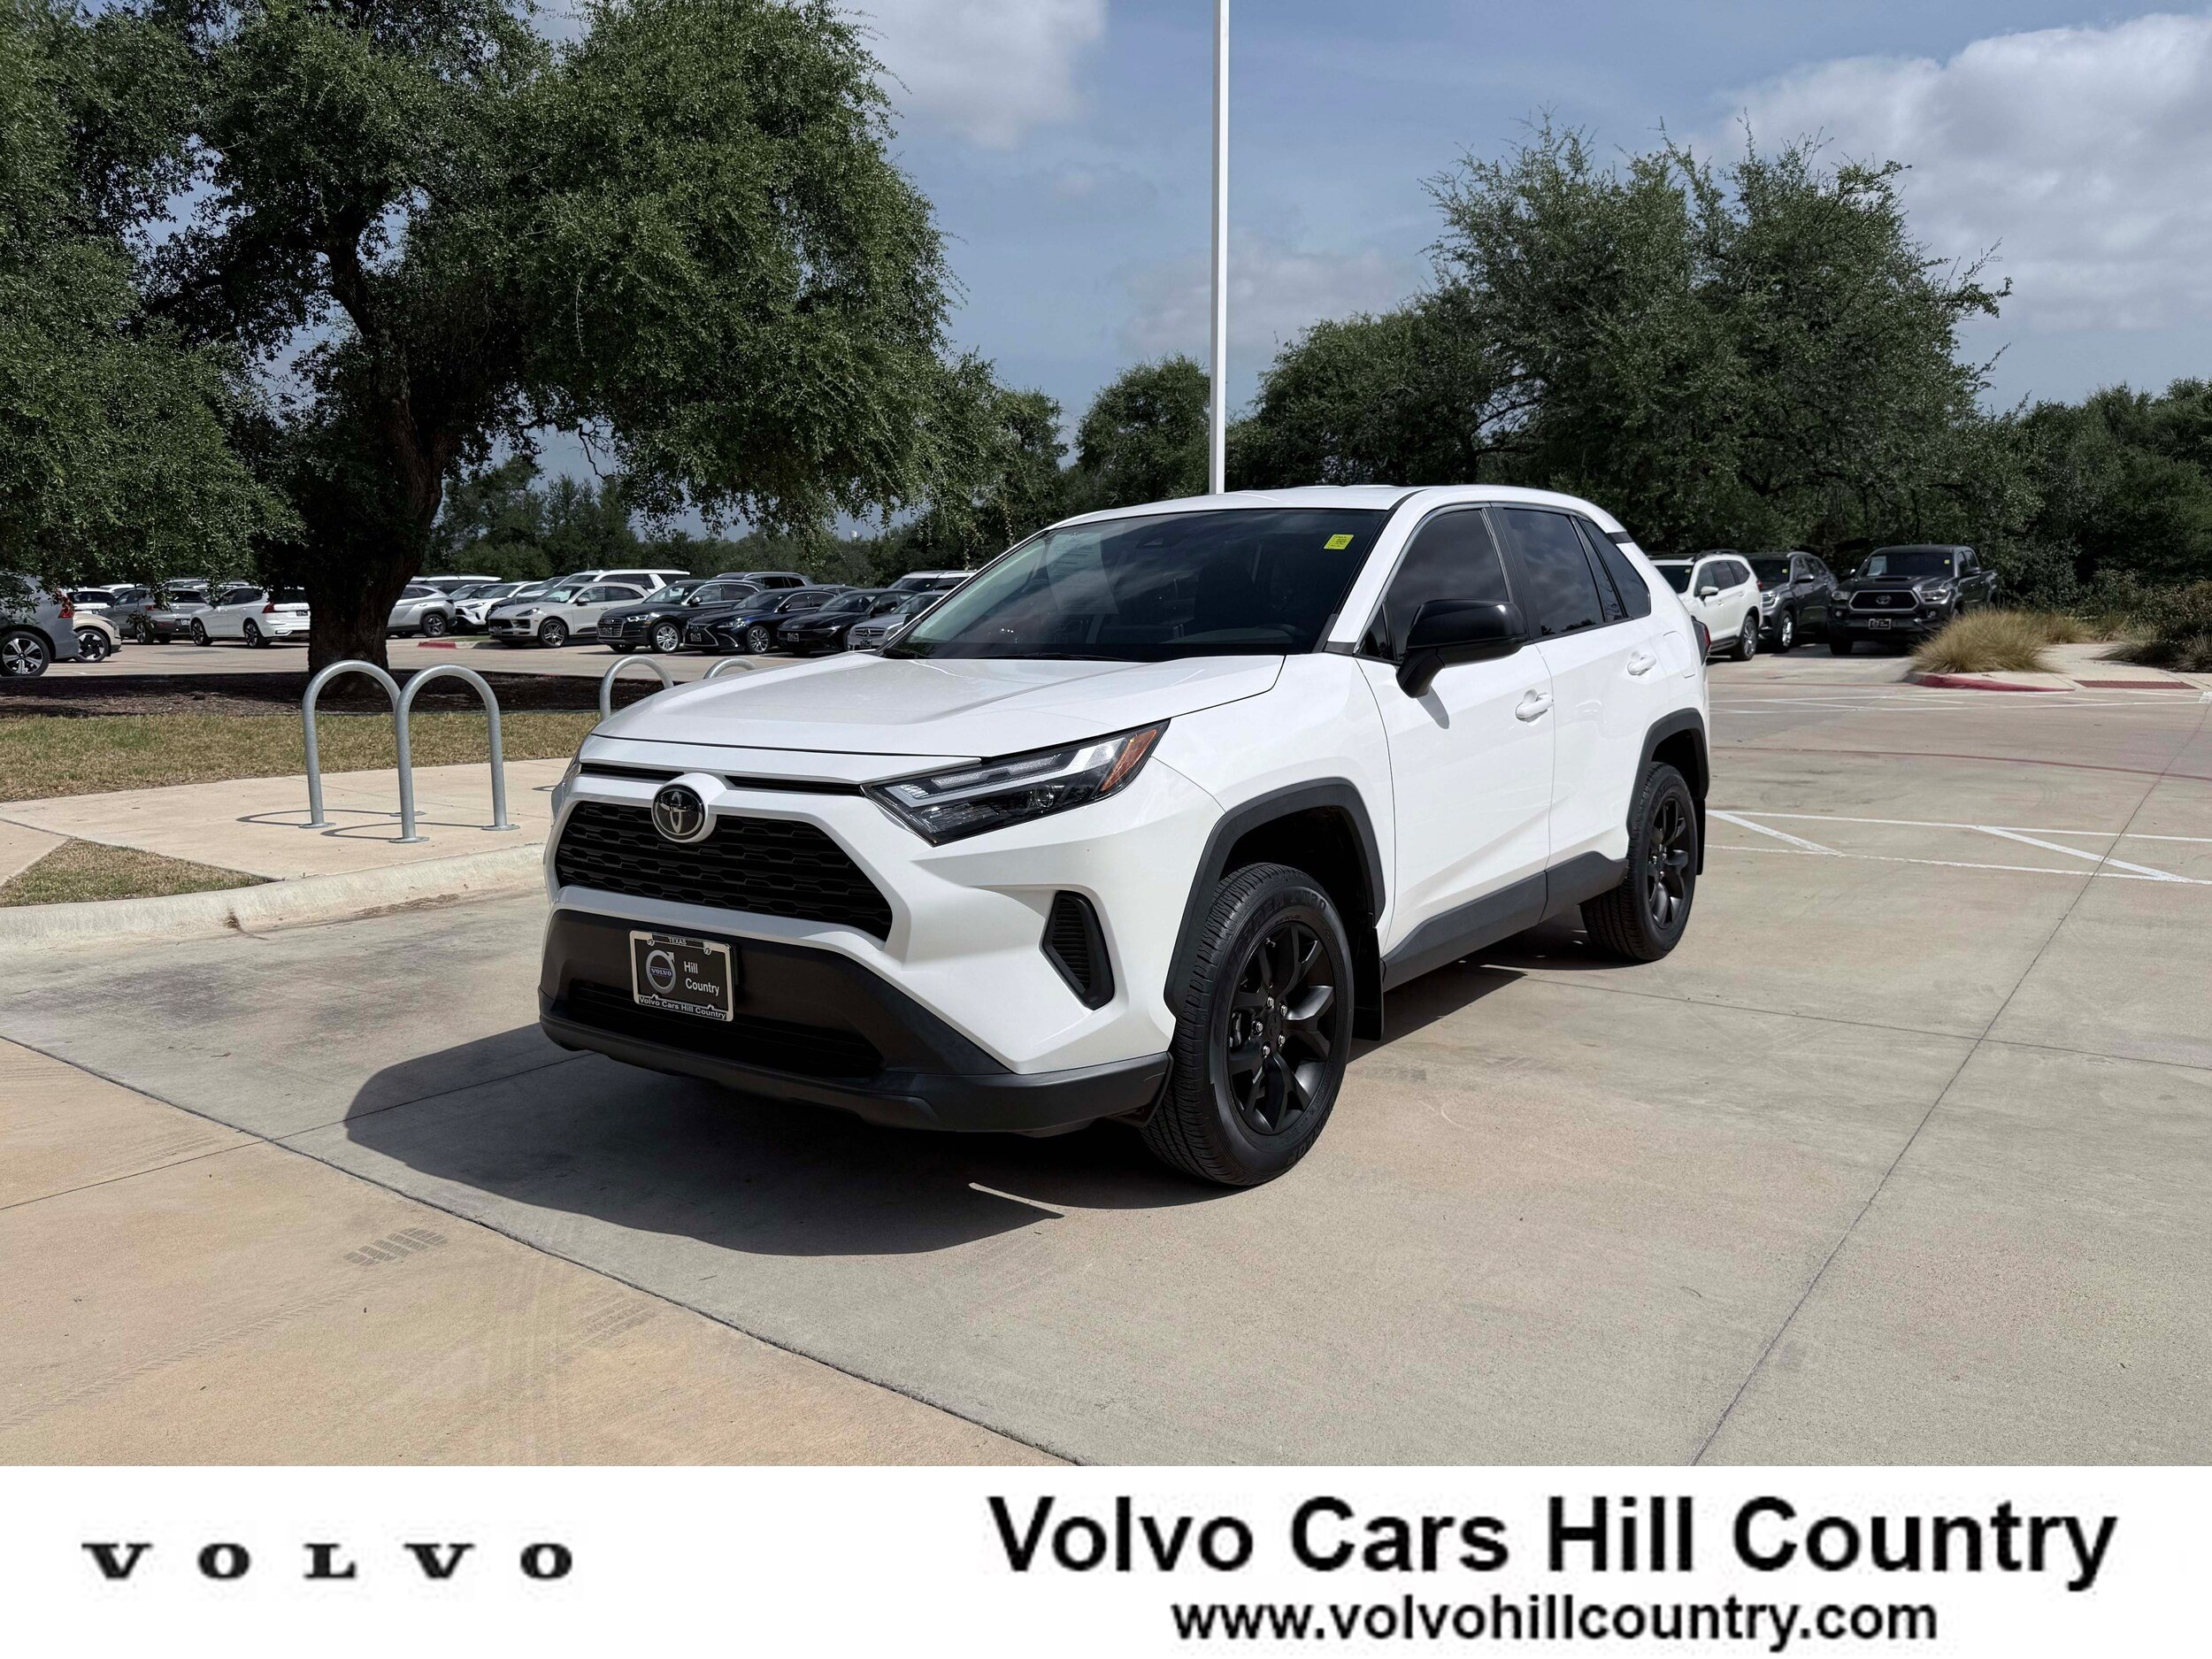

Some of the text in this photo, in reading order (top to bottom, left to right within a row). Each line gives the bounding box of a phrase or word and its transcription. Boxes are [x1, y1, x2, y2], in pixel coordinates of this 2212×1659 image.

[650, 967, 672, 977] VOLVO
[683, 961, 698, 974] Hill
[685, 978, 720, 996] Country
[639, 996, 726, 1020] Volvo Cars Hill Country
